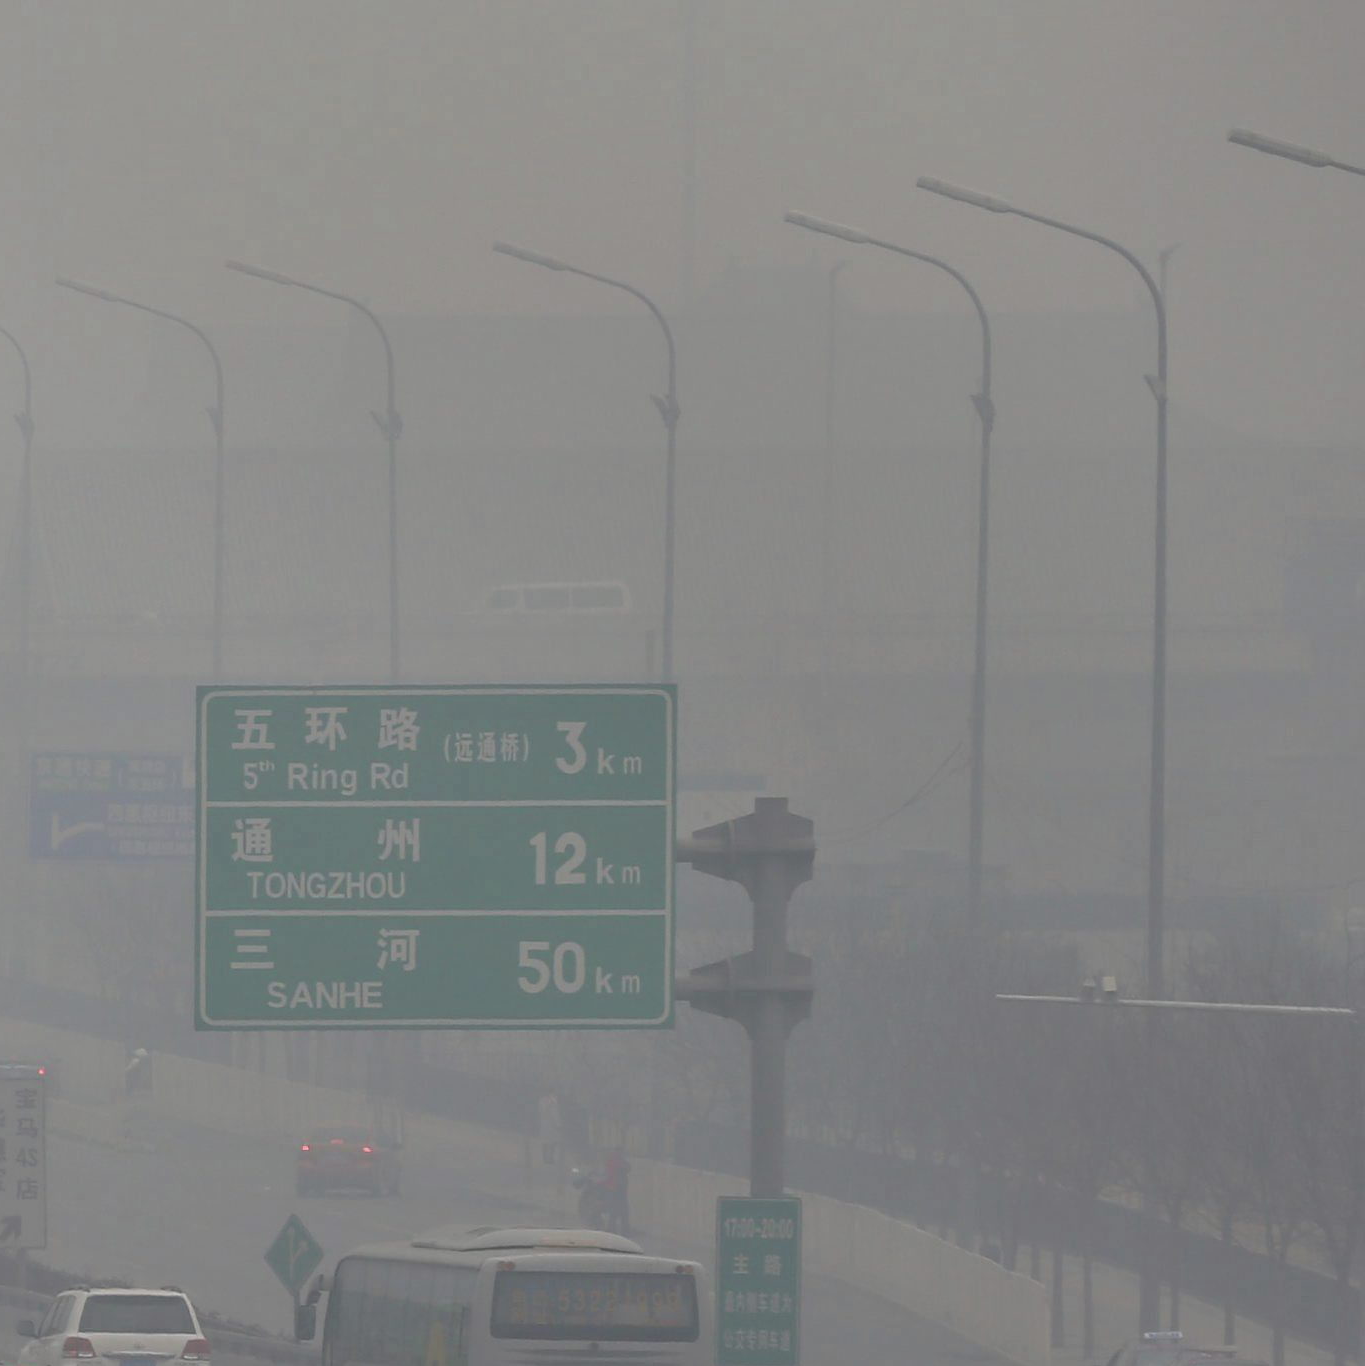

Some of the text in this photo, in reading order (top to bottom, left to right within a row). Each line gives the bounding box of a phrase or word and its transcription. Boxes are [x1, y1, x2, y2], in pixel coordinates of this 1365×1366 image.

[231, 706, 421, 752] 五环路
[555, 722, 587, 774] 3
[597, 749, 643, 775] km
[243, 761, 409, 797] 5th Ring Rd
[231, 819, 641, 885] 通州 12 km
[246, 871, 406, 899] TONGZHOU
[231, 928, 640, 994] 三河 50 km
[268, 981, 383, 1008] SANHE
